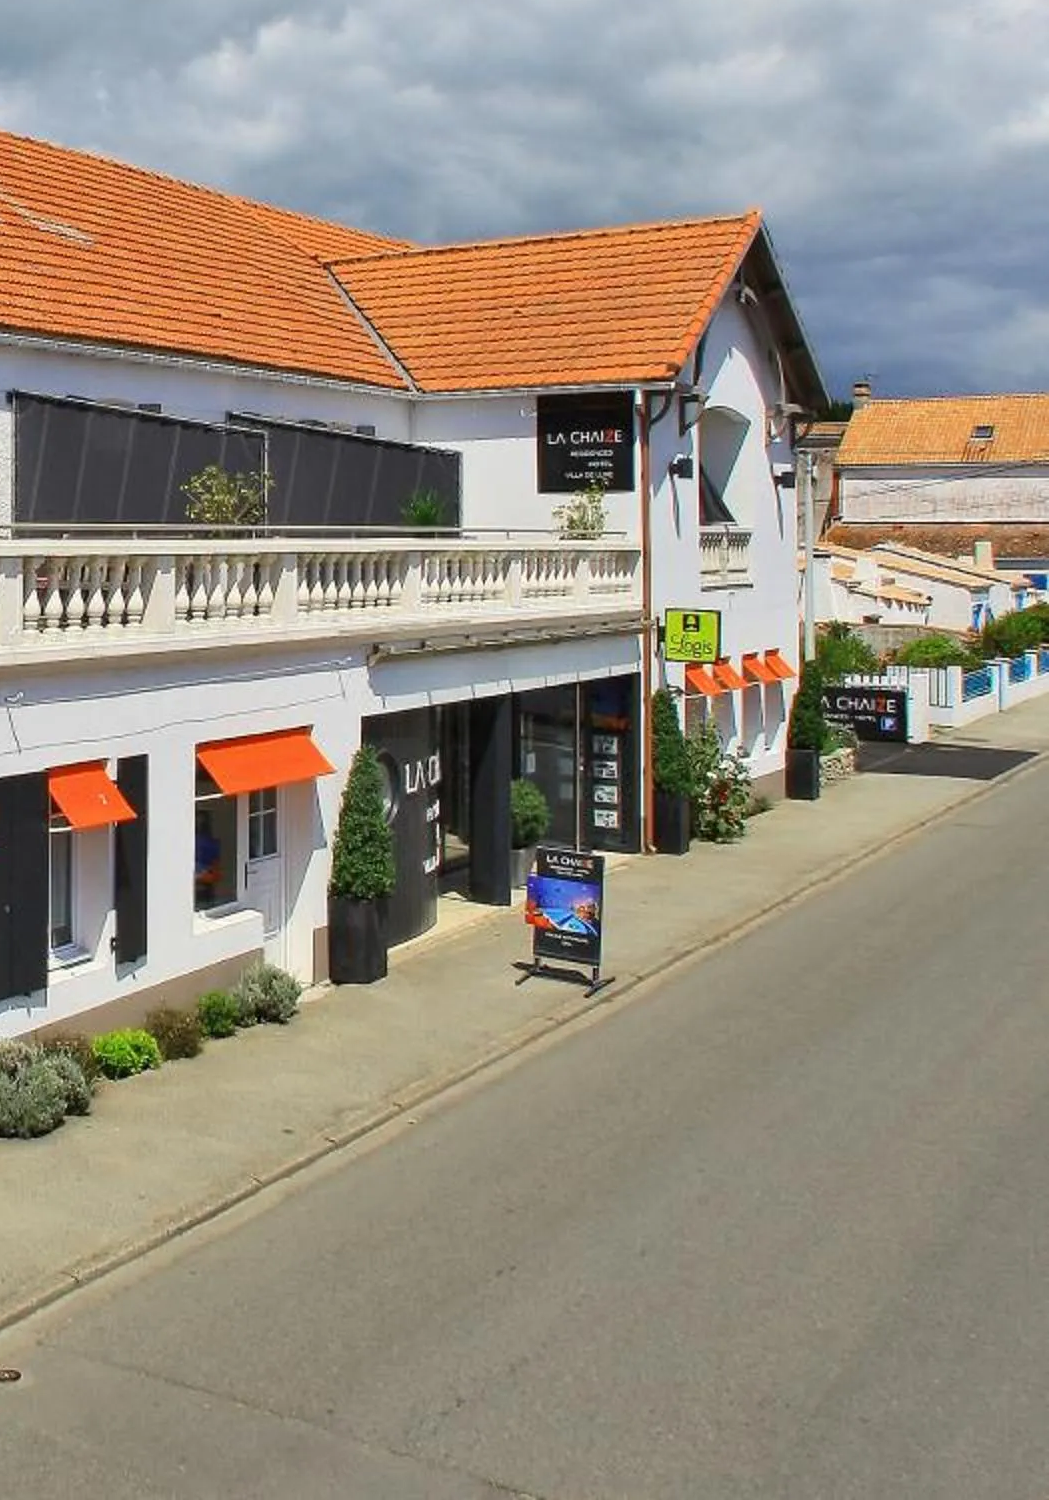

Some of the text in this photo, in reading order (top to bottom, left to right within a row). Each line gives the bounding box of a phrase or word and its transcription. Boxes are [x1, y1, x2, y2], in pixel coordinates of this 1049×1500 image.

[546, 428, 623, 445] LA CHAIZE
[836, 694, 897, 713] CHAIZE
[404, 761, 426, 794] LA
